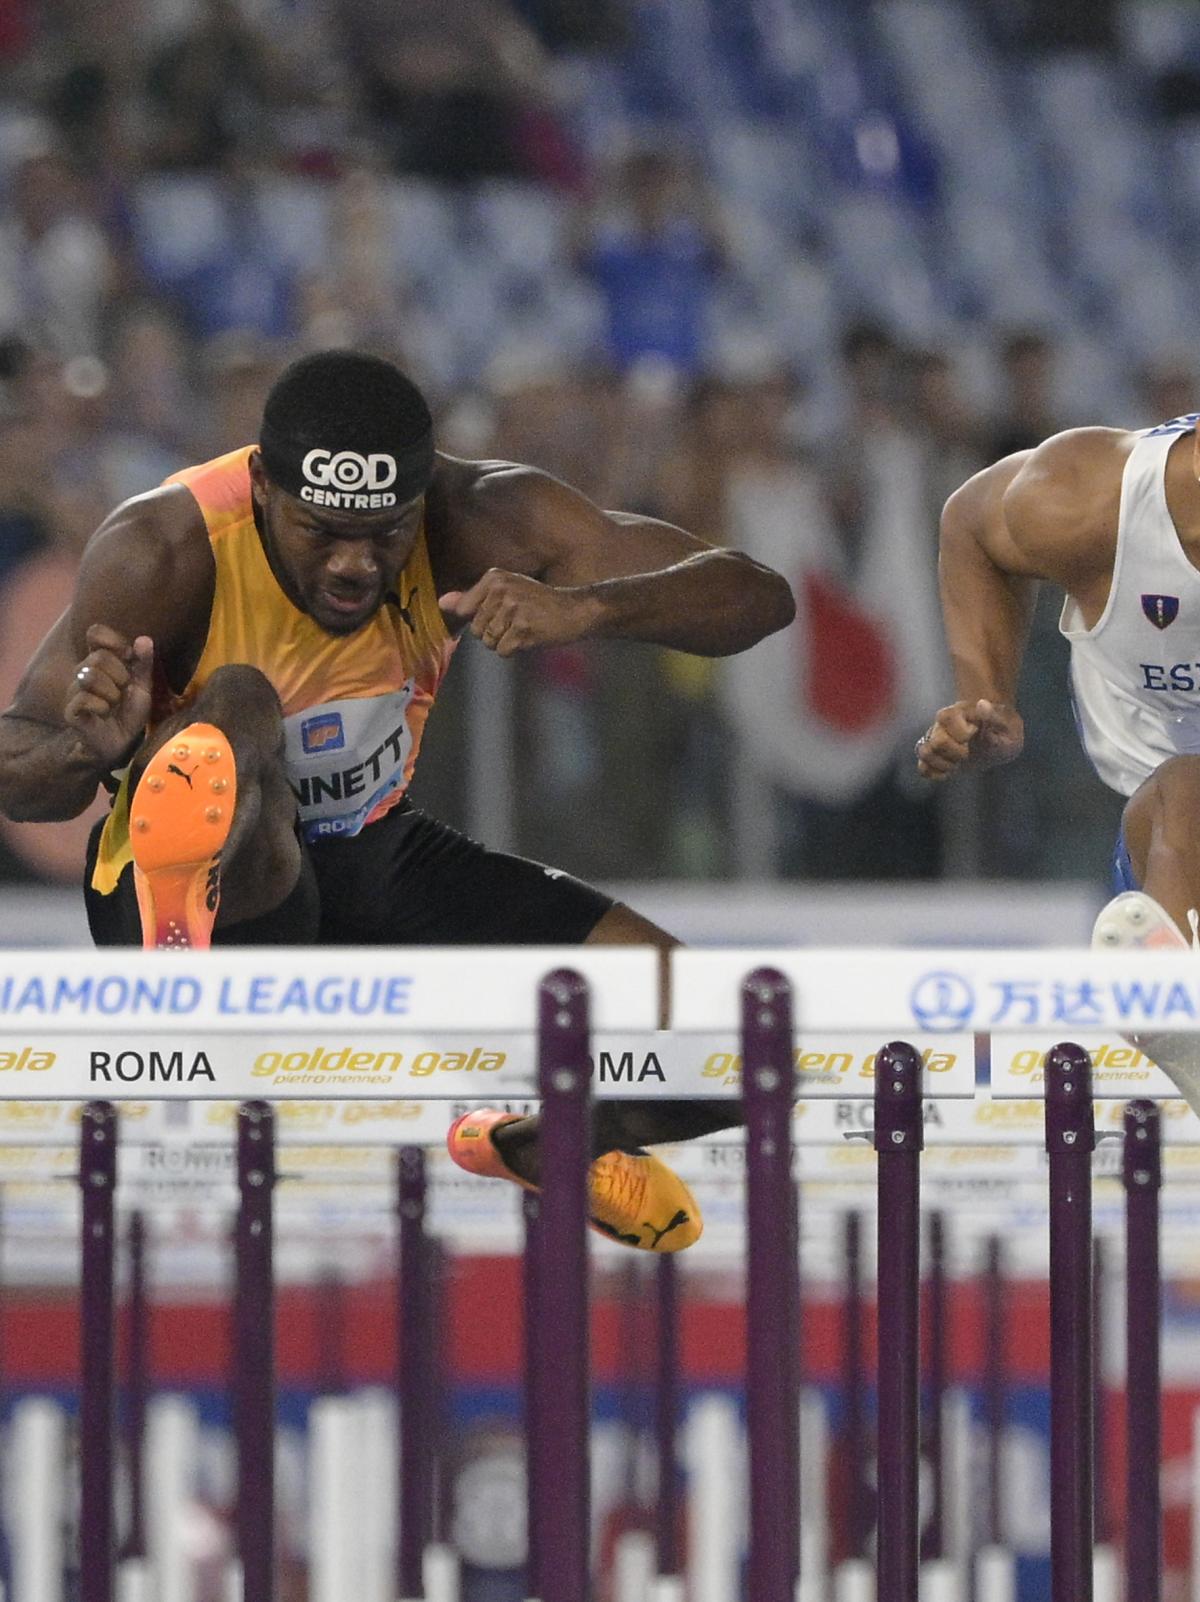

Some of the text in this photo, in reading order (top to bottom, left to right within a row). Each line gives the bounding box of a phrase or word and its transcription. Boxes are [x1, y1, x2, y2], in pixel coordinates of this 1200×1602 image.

[302, 448, 397, 491] GOD
[300, 485, 397, 509] CENTRED
[0, 974, 415, 1016] IAMOND LEAGUE
[989, 978, 1106, 1026] 万达
[90, 1051, 217, 1082] ROMA
[250, 1047, 404, 1077] golden
[408, 1047, 508, 1077] gala
[586, 1051, 667, 1082] MA
